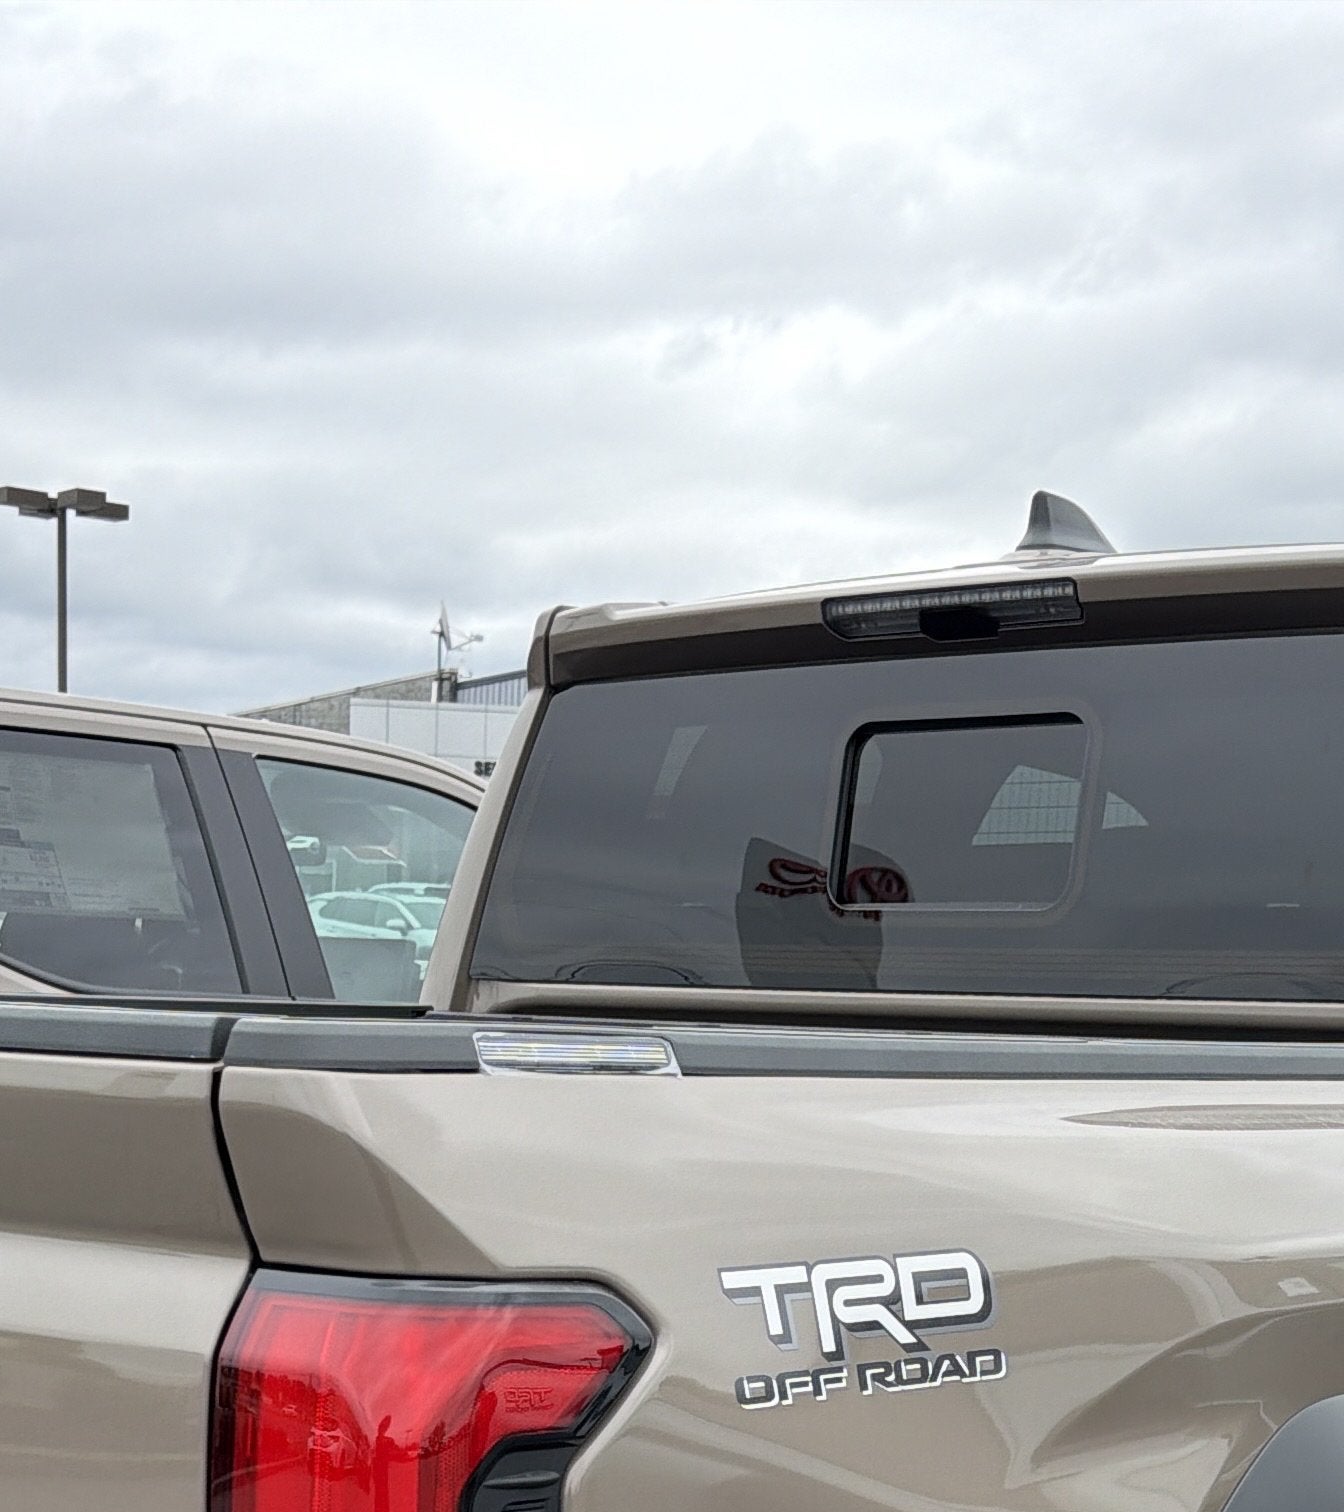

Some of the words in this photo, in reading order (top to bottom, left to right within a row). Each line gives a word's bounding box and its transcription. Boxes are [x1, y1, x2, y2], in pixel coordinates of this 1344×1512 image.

[717, 1247, 996, 1366] TRD
[735, 1366, 848, 1410] OFF
[856, 1348, 1007, 1396] ROAD
